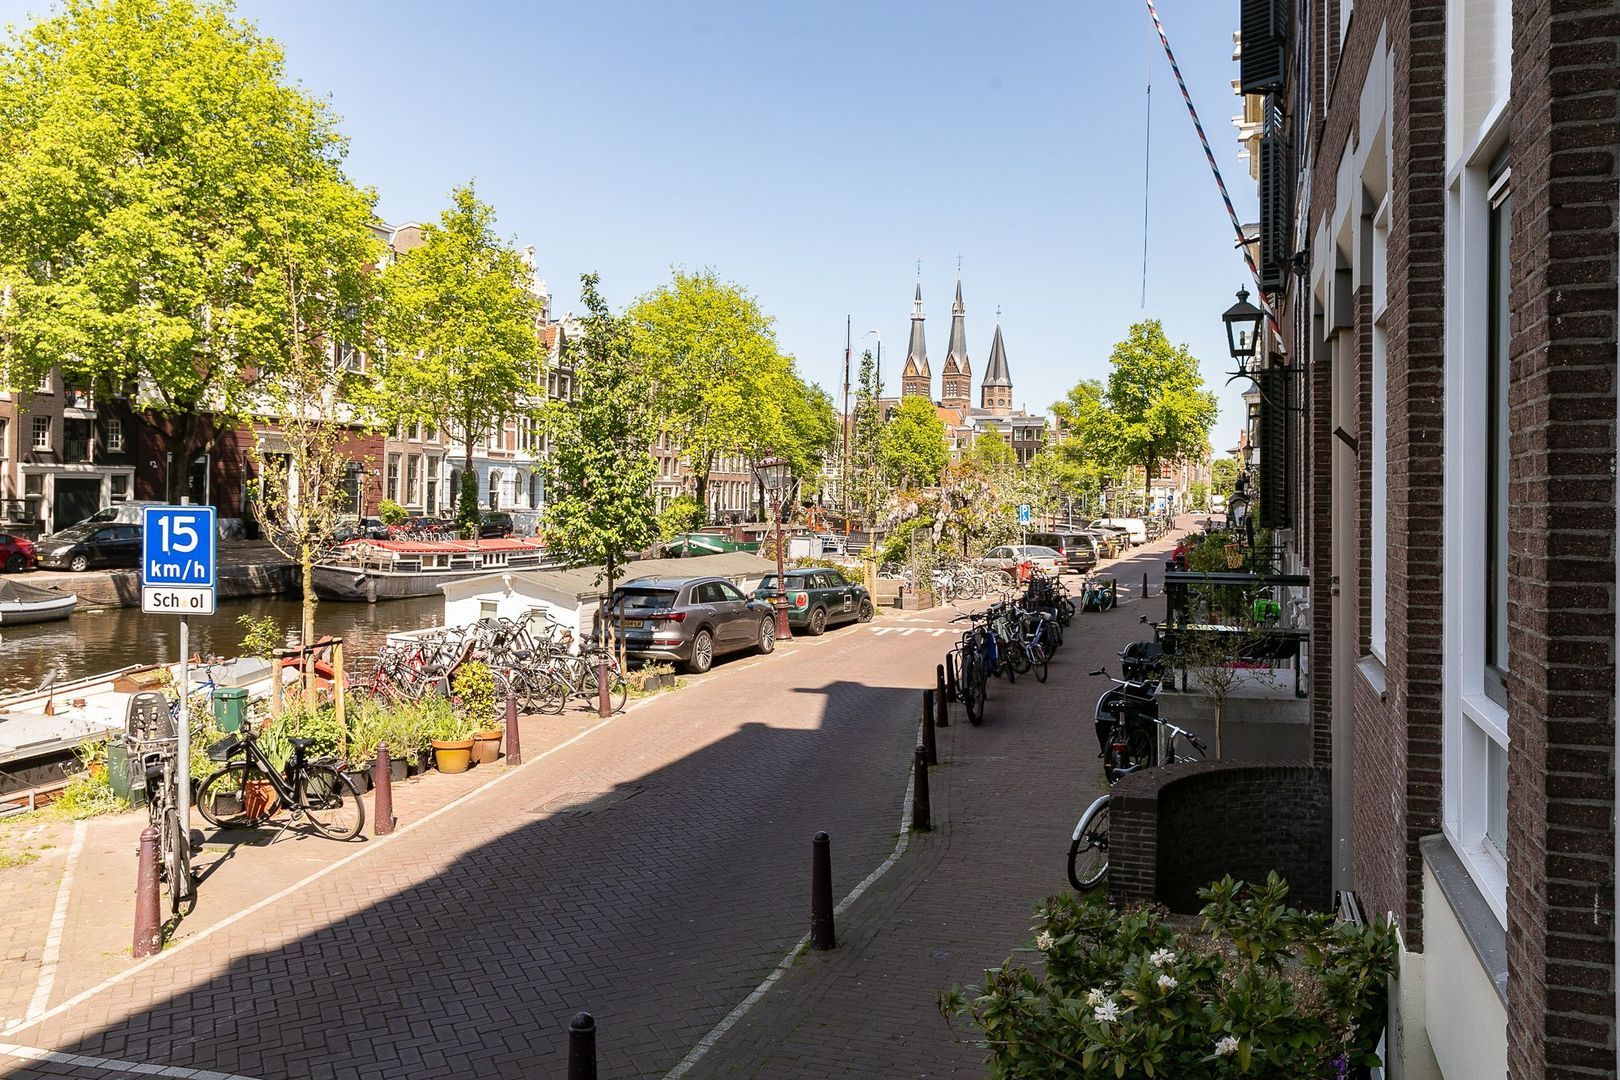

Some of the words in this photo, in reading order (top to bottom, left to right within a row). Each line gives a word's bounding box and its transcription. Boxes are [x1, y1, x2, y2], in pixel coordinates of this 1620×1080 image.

[158, 516, 198, 552] 15
[151, 560, 205, 580] km/h
[153, 593, 203, 608] Schol
